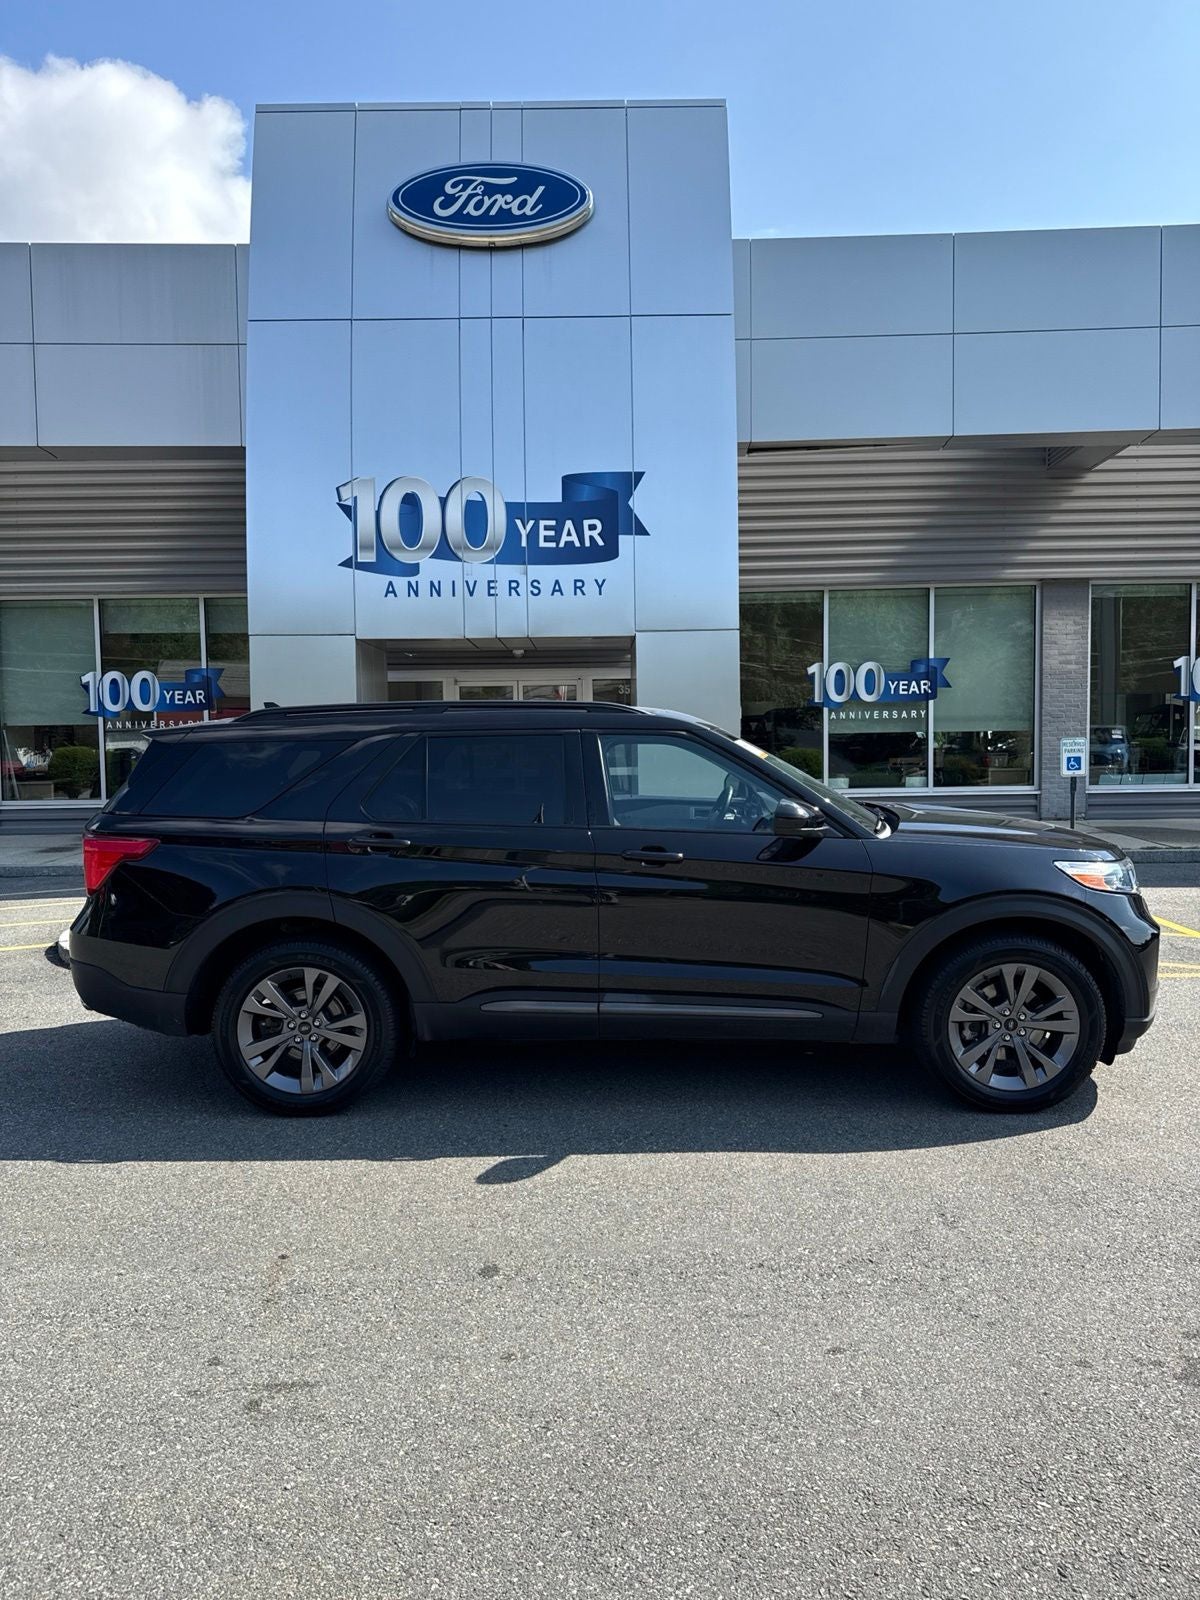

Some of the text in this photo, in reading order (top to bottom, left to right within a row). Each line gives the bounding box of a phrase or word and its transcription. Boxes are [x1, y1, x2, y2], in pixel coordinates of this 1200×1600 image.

[433, 175, 546, 217] Ford
[336, 475, 606, 564] 100 YEAR
[384, 578, 608, 598] ANNIVERSARY
[81, 670, 206, 712] 100 YEAR
[807, 662, 932, 702] 100 YEAR
[1173, 656, 1200, 697] 1
[830, 710, 926, 720] ANNIVERSARY
